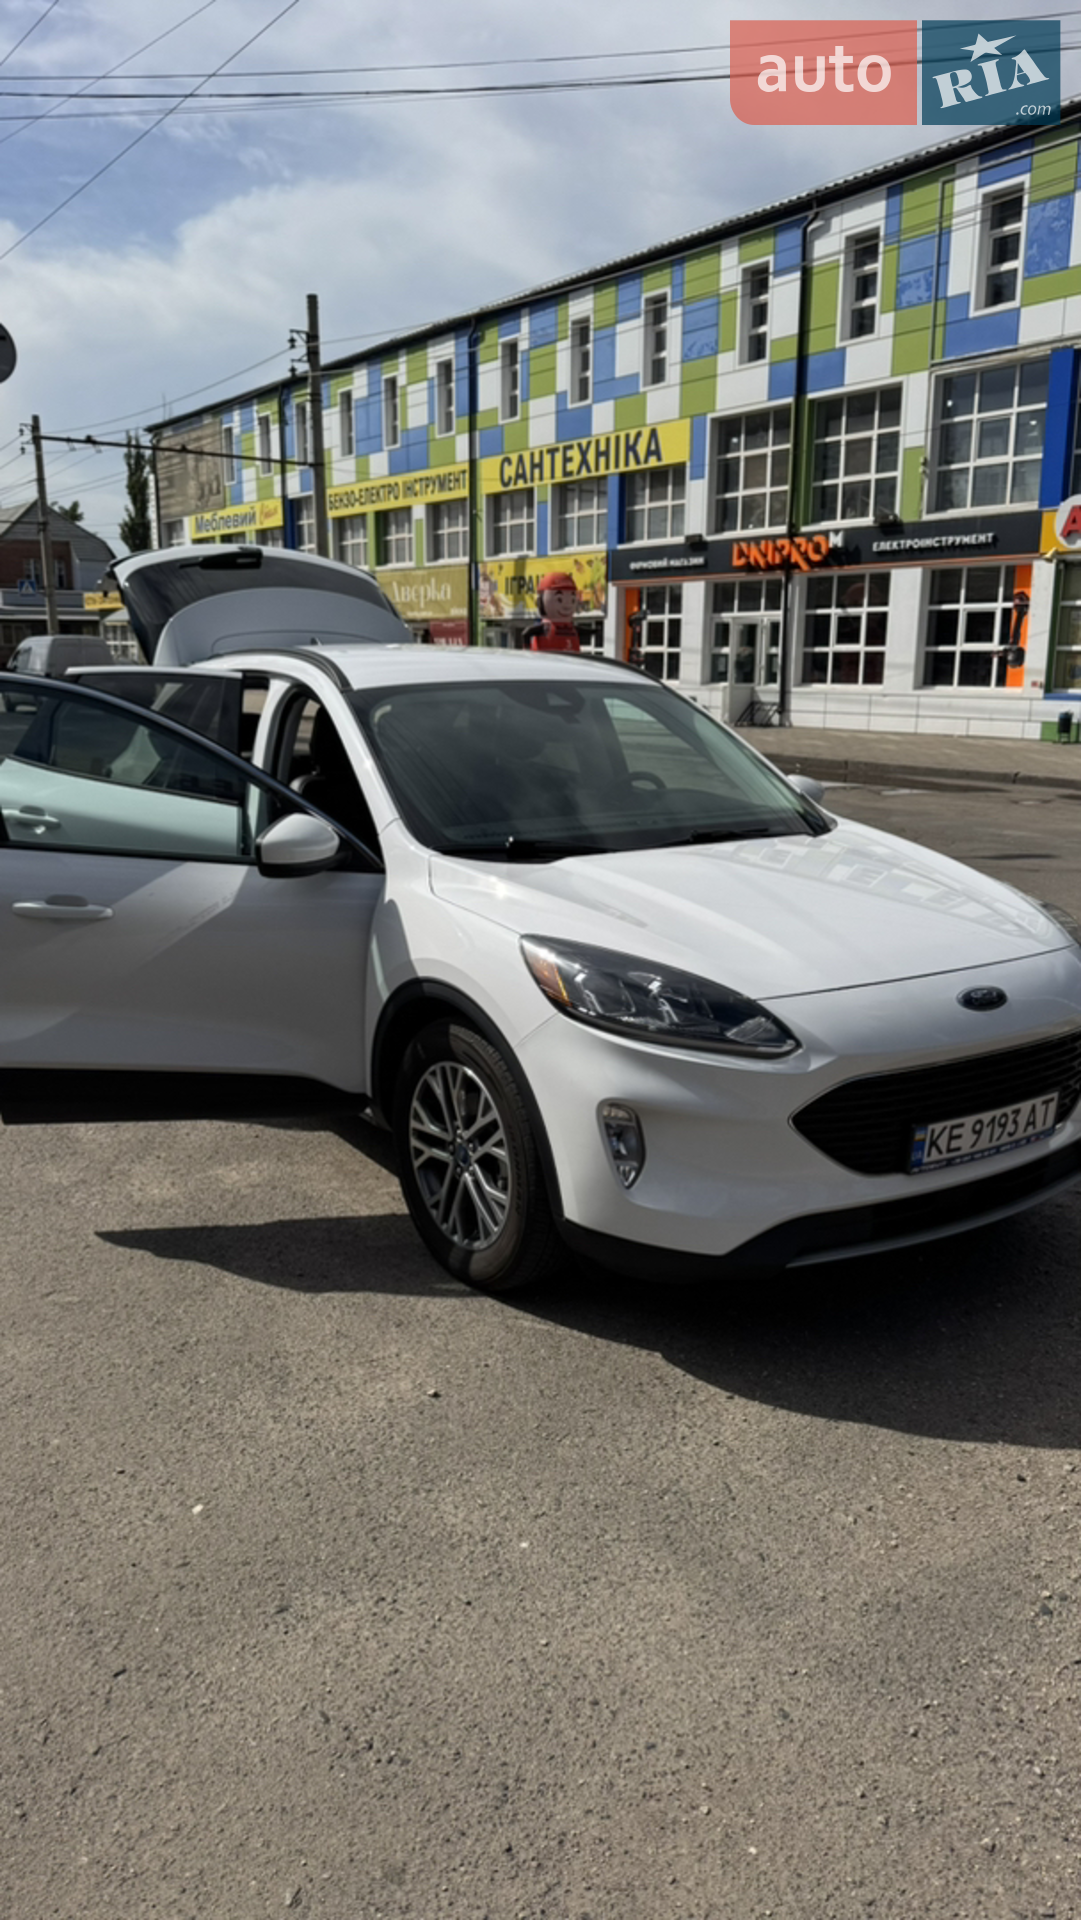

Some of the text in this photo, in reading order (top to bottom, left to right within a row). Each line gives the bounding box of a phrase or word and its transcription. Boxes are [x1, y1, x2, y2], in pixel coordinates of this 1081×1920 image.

[500, 427, 662, 488] САНТЕХНІКА
[328, 469, 467, 511] БЕНЗО-ЕЛЕКТРО ІНСТРУМЕНТ
[195, 505, 256, 533] Меблевий
[872, 532, 995, 552] ЕЛЕКТРОІНСТРУМЕНТ
[926, 1122, 965, 1159] KE
[969, 1108, 1022, 1149] 9193
[1023, 1097, 1056, 1133] AT
